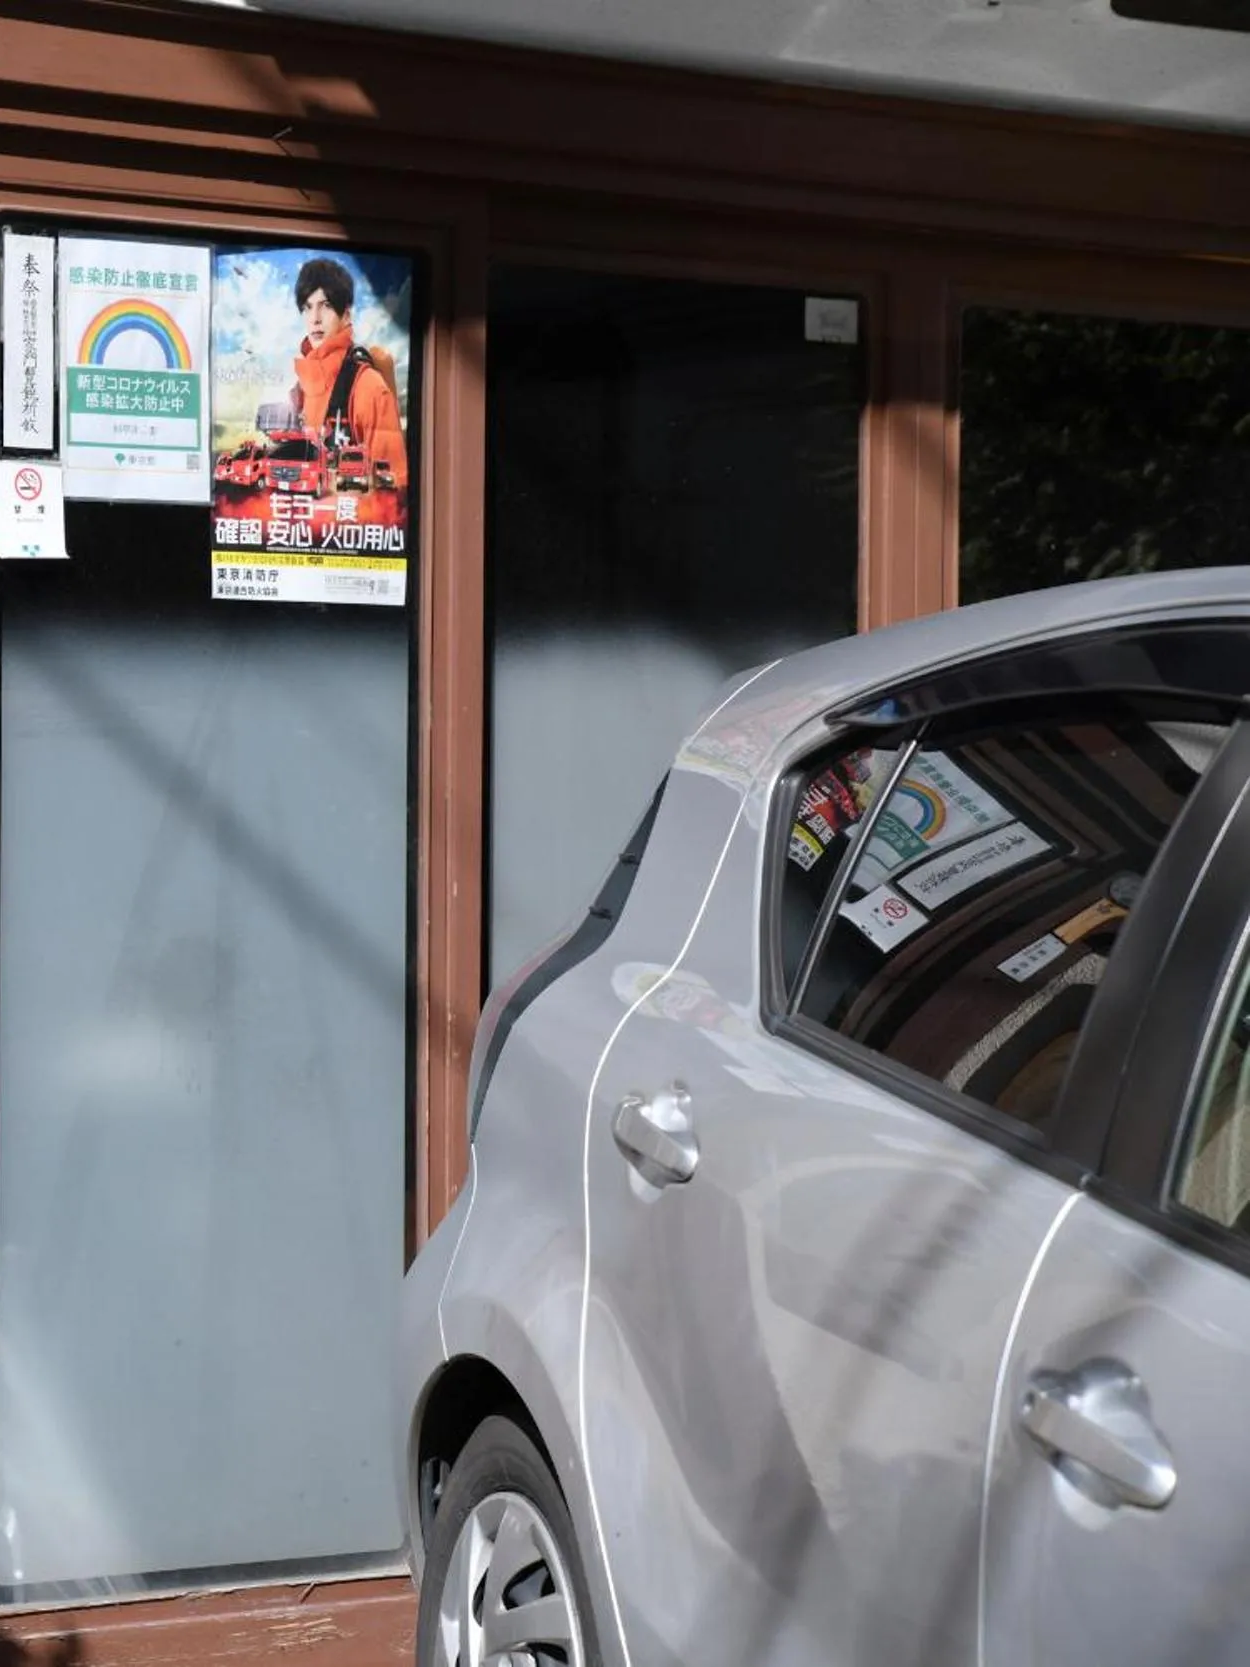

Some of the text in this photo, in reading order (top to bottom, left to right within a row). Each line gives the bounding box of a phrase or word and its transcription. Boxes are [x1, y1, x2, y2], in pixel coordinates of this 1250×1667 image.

[69, 266, 198, 292] 感染防止徹底宣言
[76, 373, 191, 394] 新型コロナウイルス
[85, 392, 185, 413] 感染拡大防止中
[269, 493, 359, 522] もう一度
[214, 517, 404, 551] 確認 安心 火の用心
